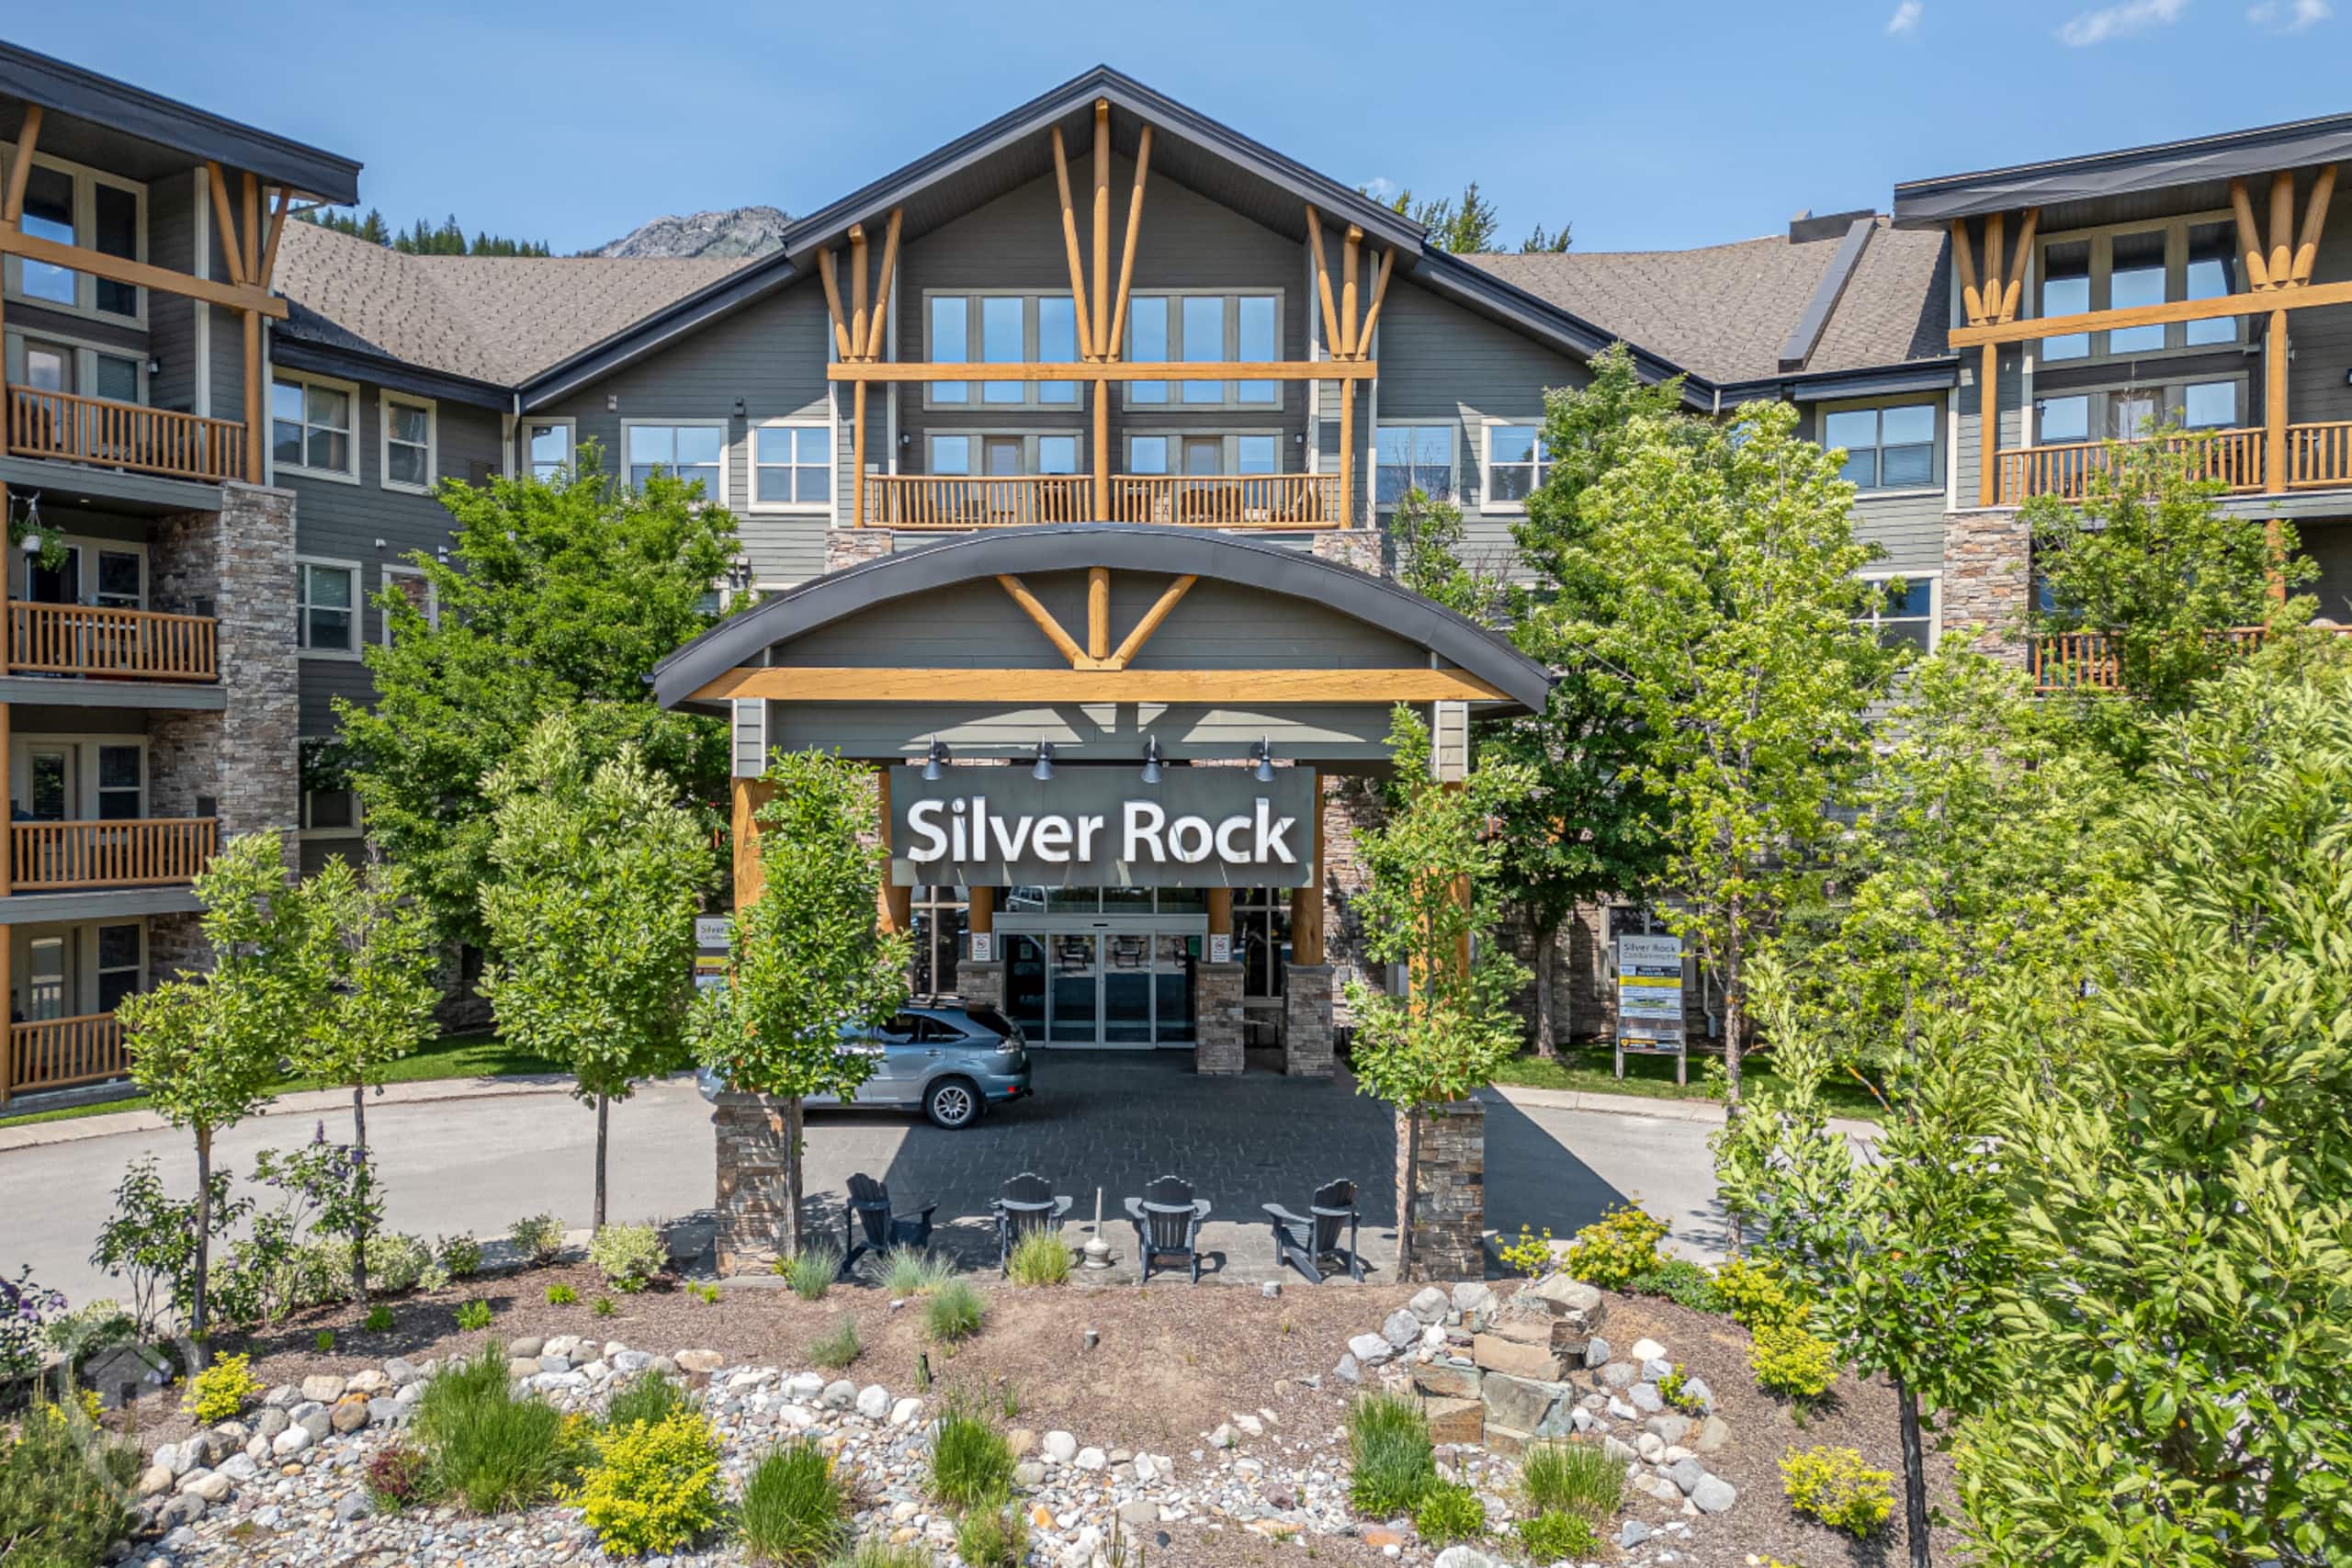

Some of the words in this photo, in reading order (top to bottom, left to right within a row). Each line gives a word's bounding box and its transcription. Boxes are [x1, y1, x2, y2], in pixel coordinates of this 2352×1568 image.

[907, 795, 1103, 863] Silver
[1123, 797, 1297, 863] Rock
[1623, 942, 1650, 952] Silver
